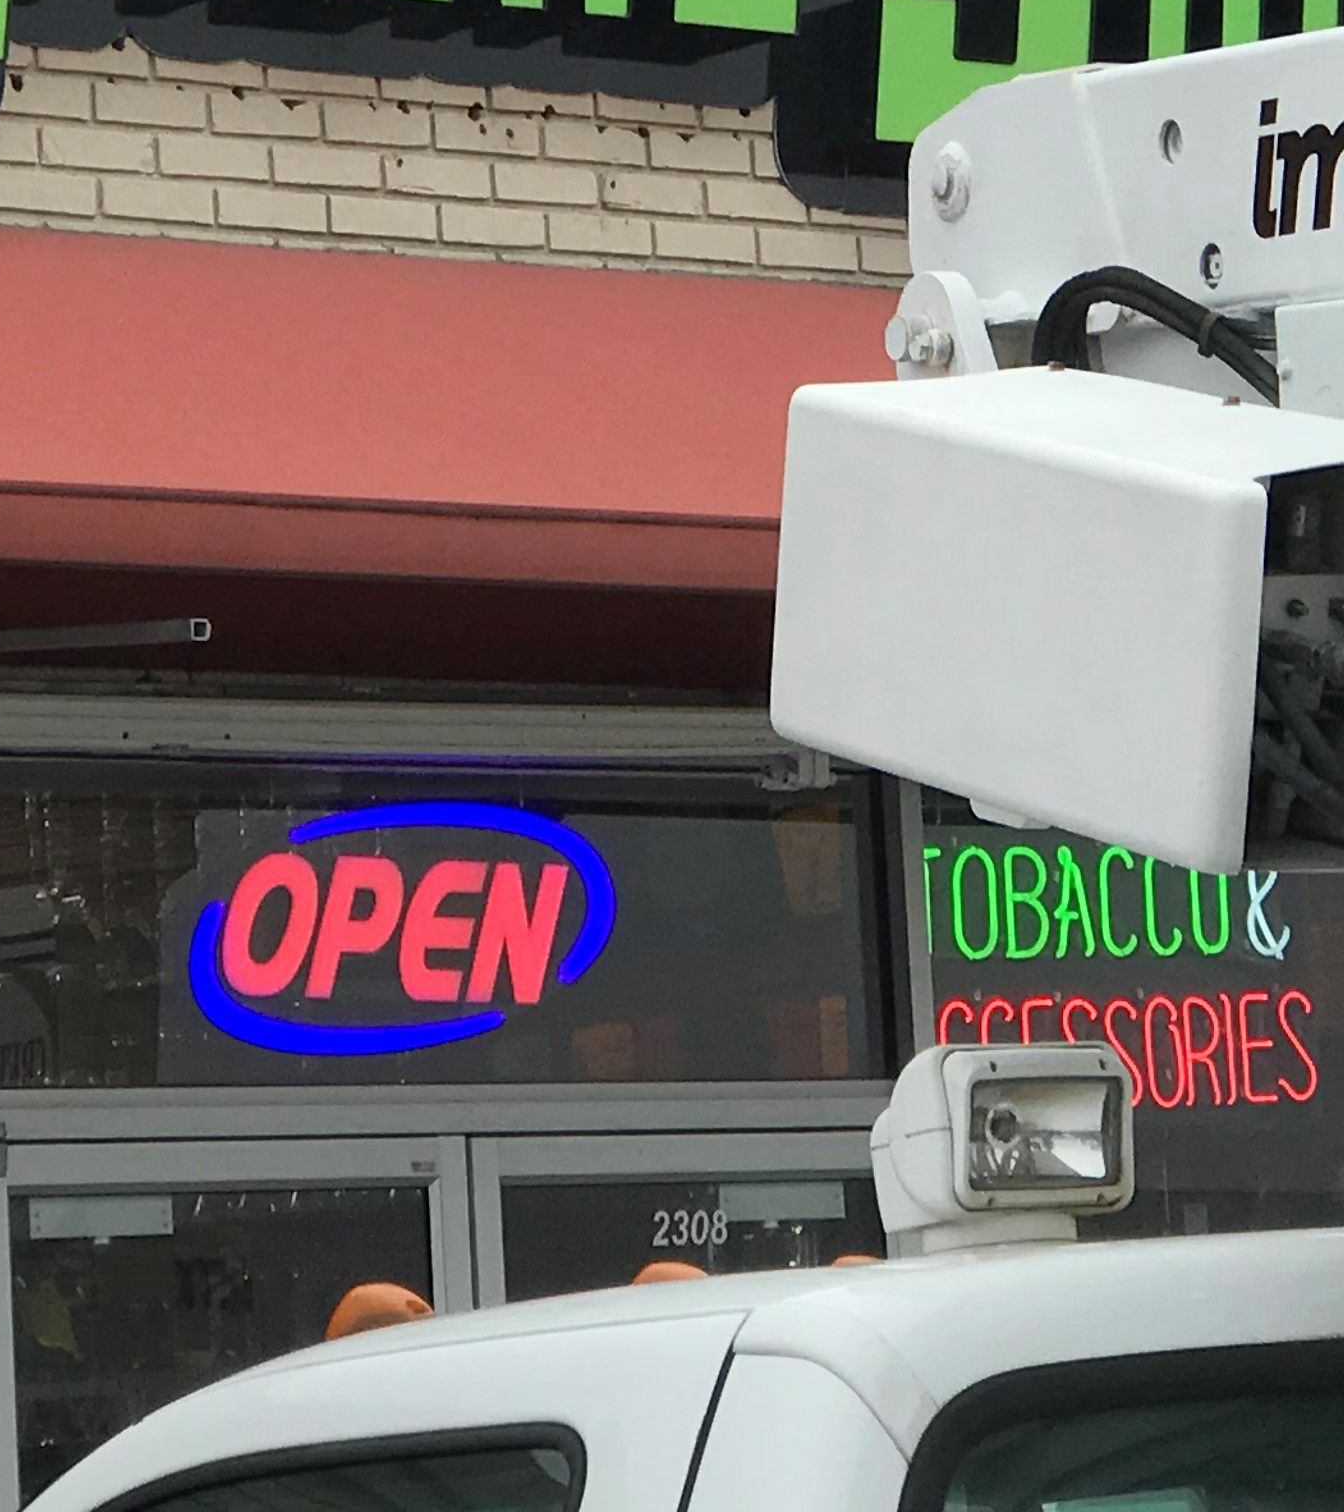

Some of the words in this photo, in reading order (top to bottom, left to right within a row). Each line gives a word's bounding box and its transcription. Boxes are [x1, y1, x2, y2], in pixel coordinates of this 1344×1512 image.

[221, 852, 569, 1005] OPEN
[1247, 870, 1291, 960] &
[652, 1209, 728, 1246] 2308
